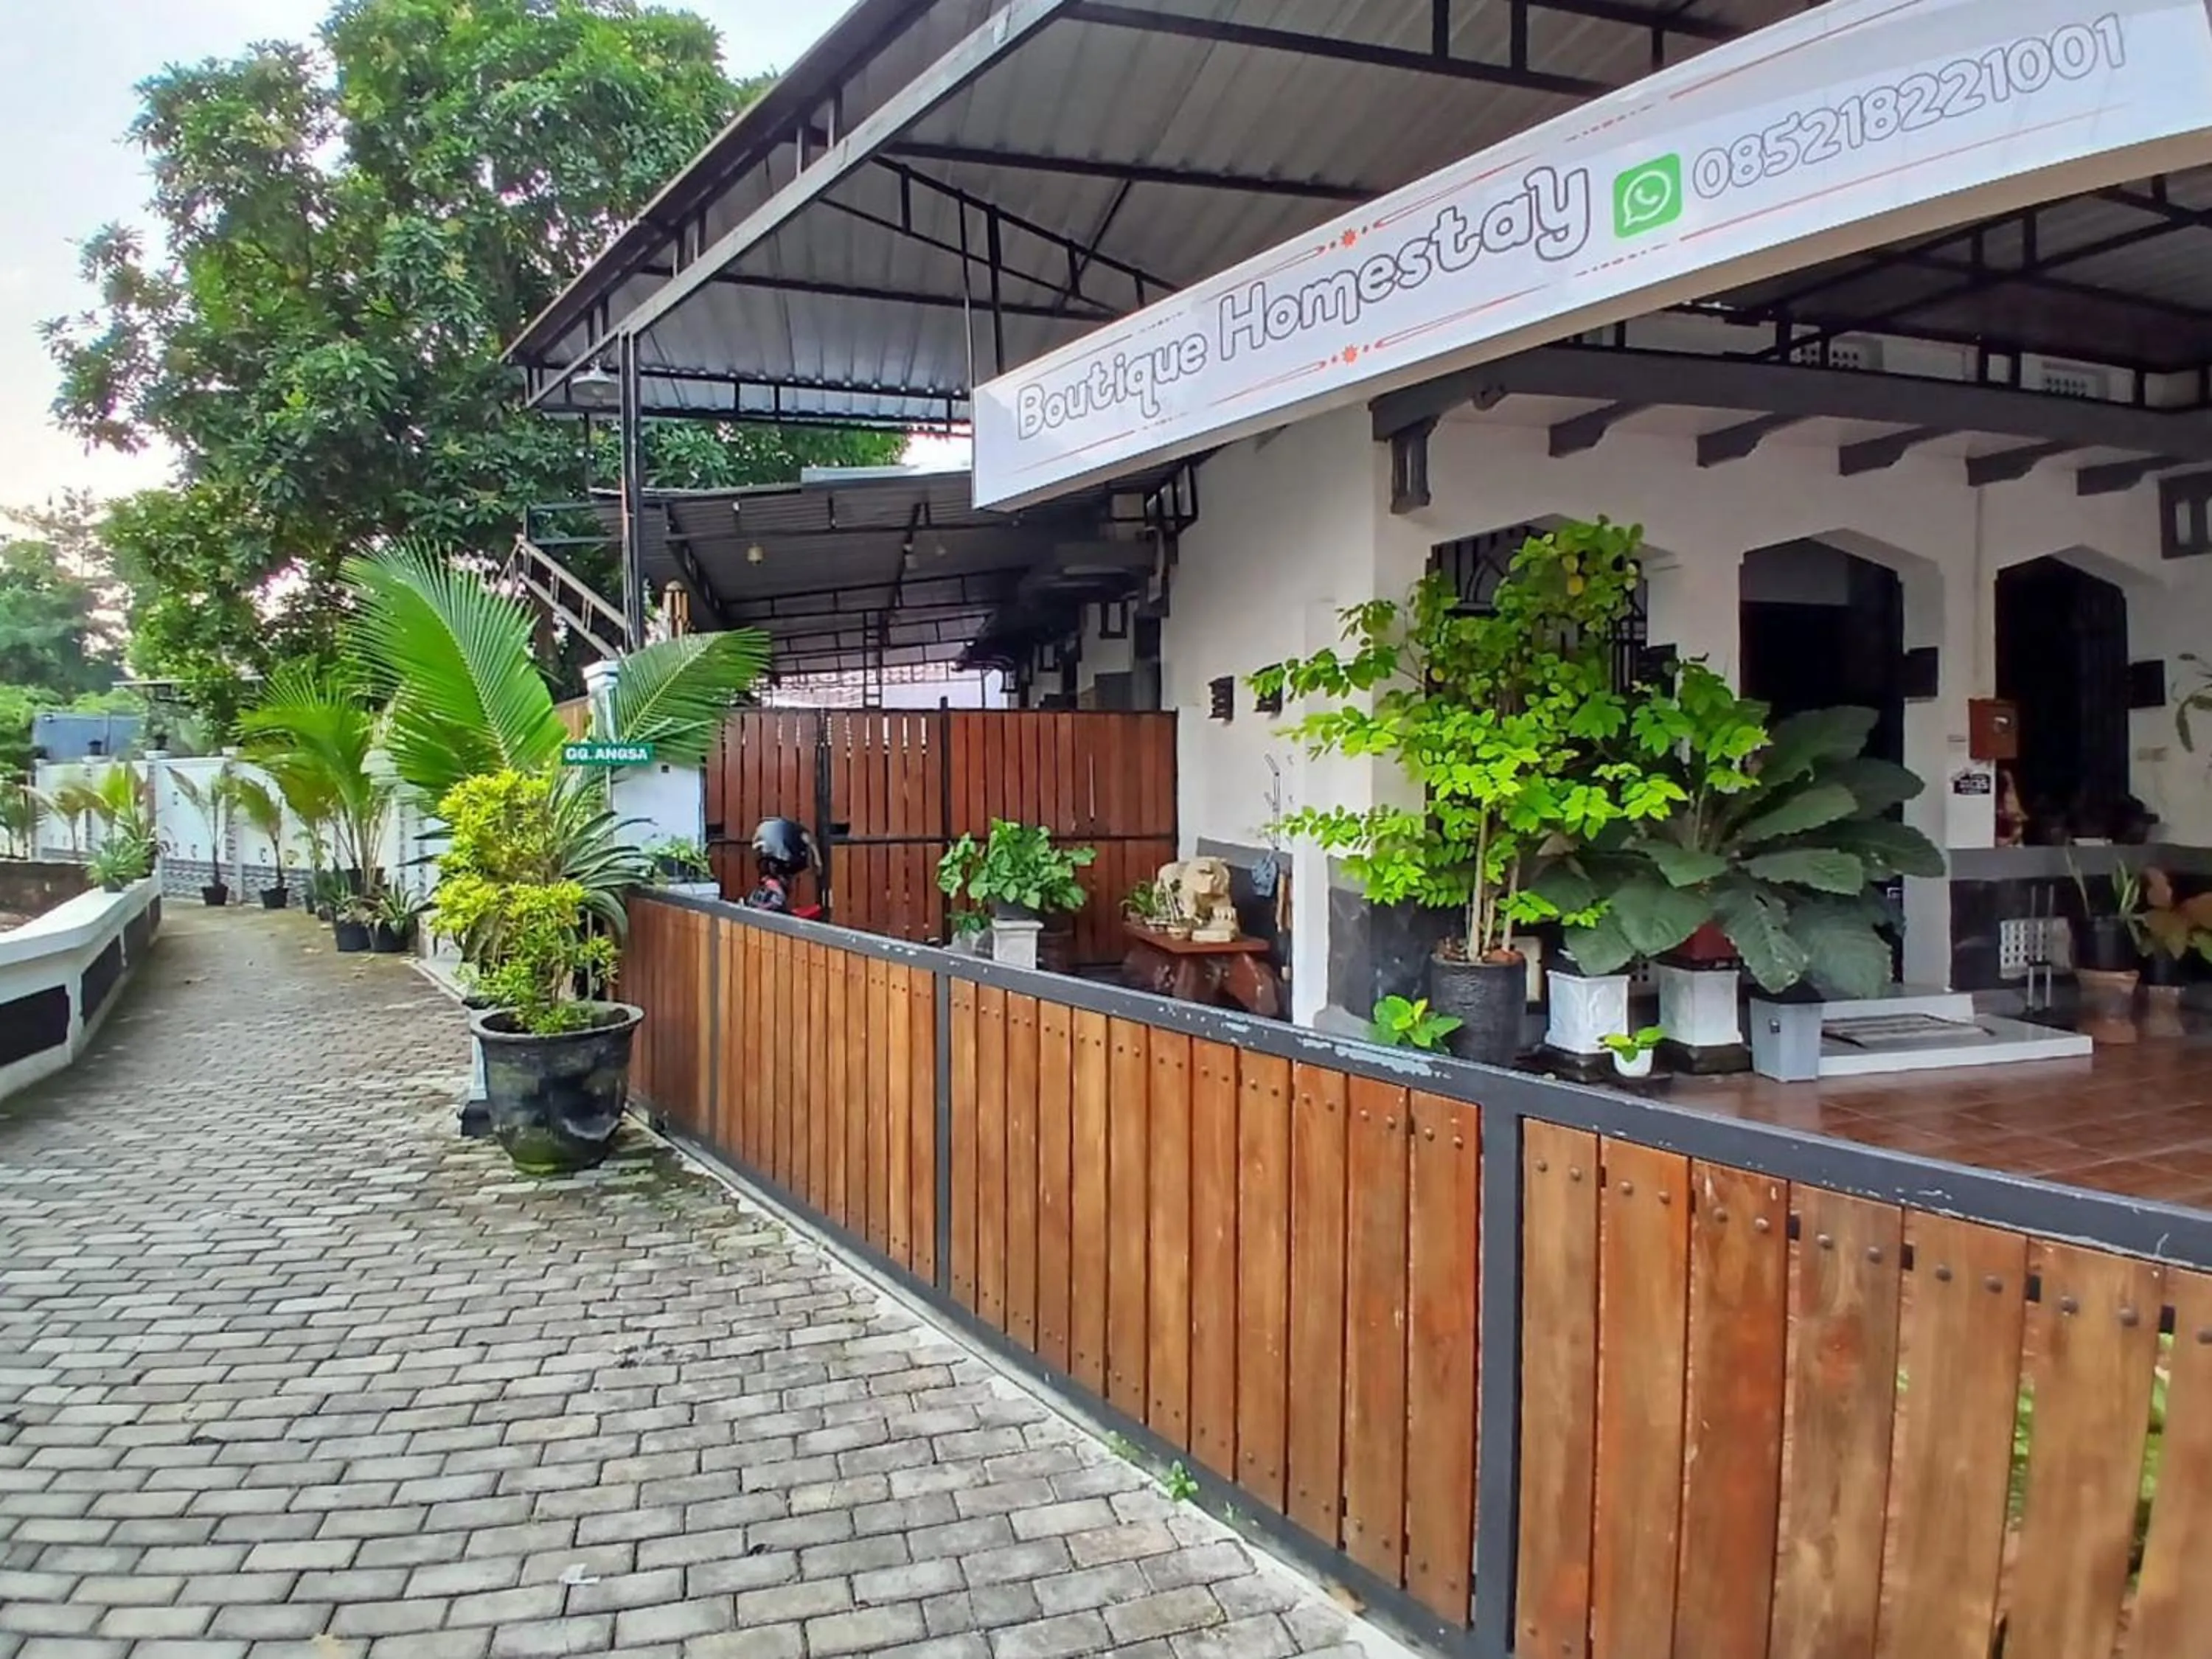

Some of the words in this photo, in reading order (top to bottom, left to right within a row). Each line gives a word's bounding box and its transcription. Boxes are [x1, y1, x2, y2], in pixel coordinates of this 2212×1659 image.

[1017, 327, 1208, 441] Boutique
[1220, 167, 1590, 361] Homestay
[1691, 13, 2126, 200] 085218221001
[594, 747, 648, 761] ANGSA
